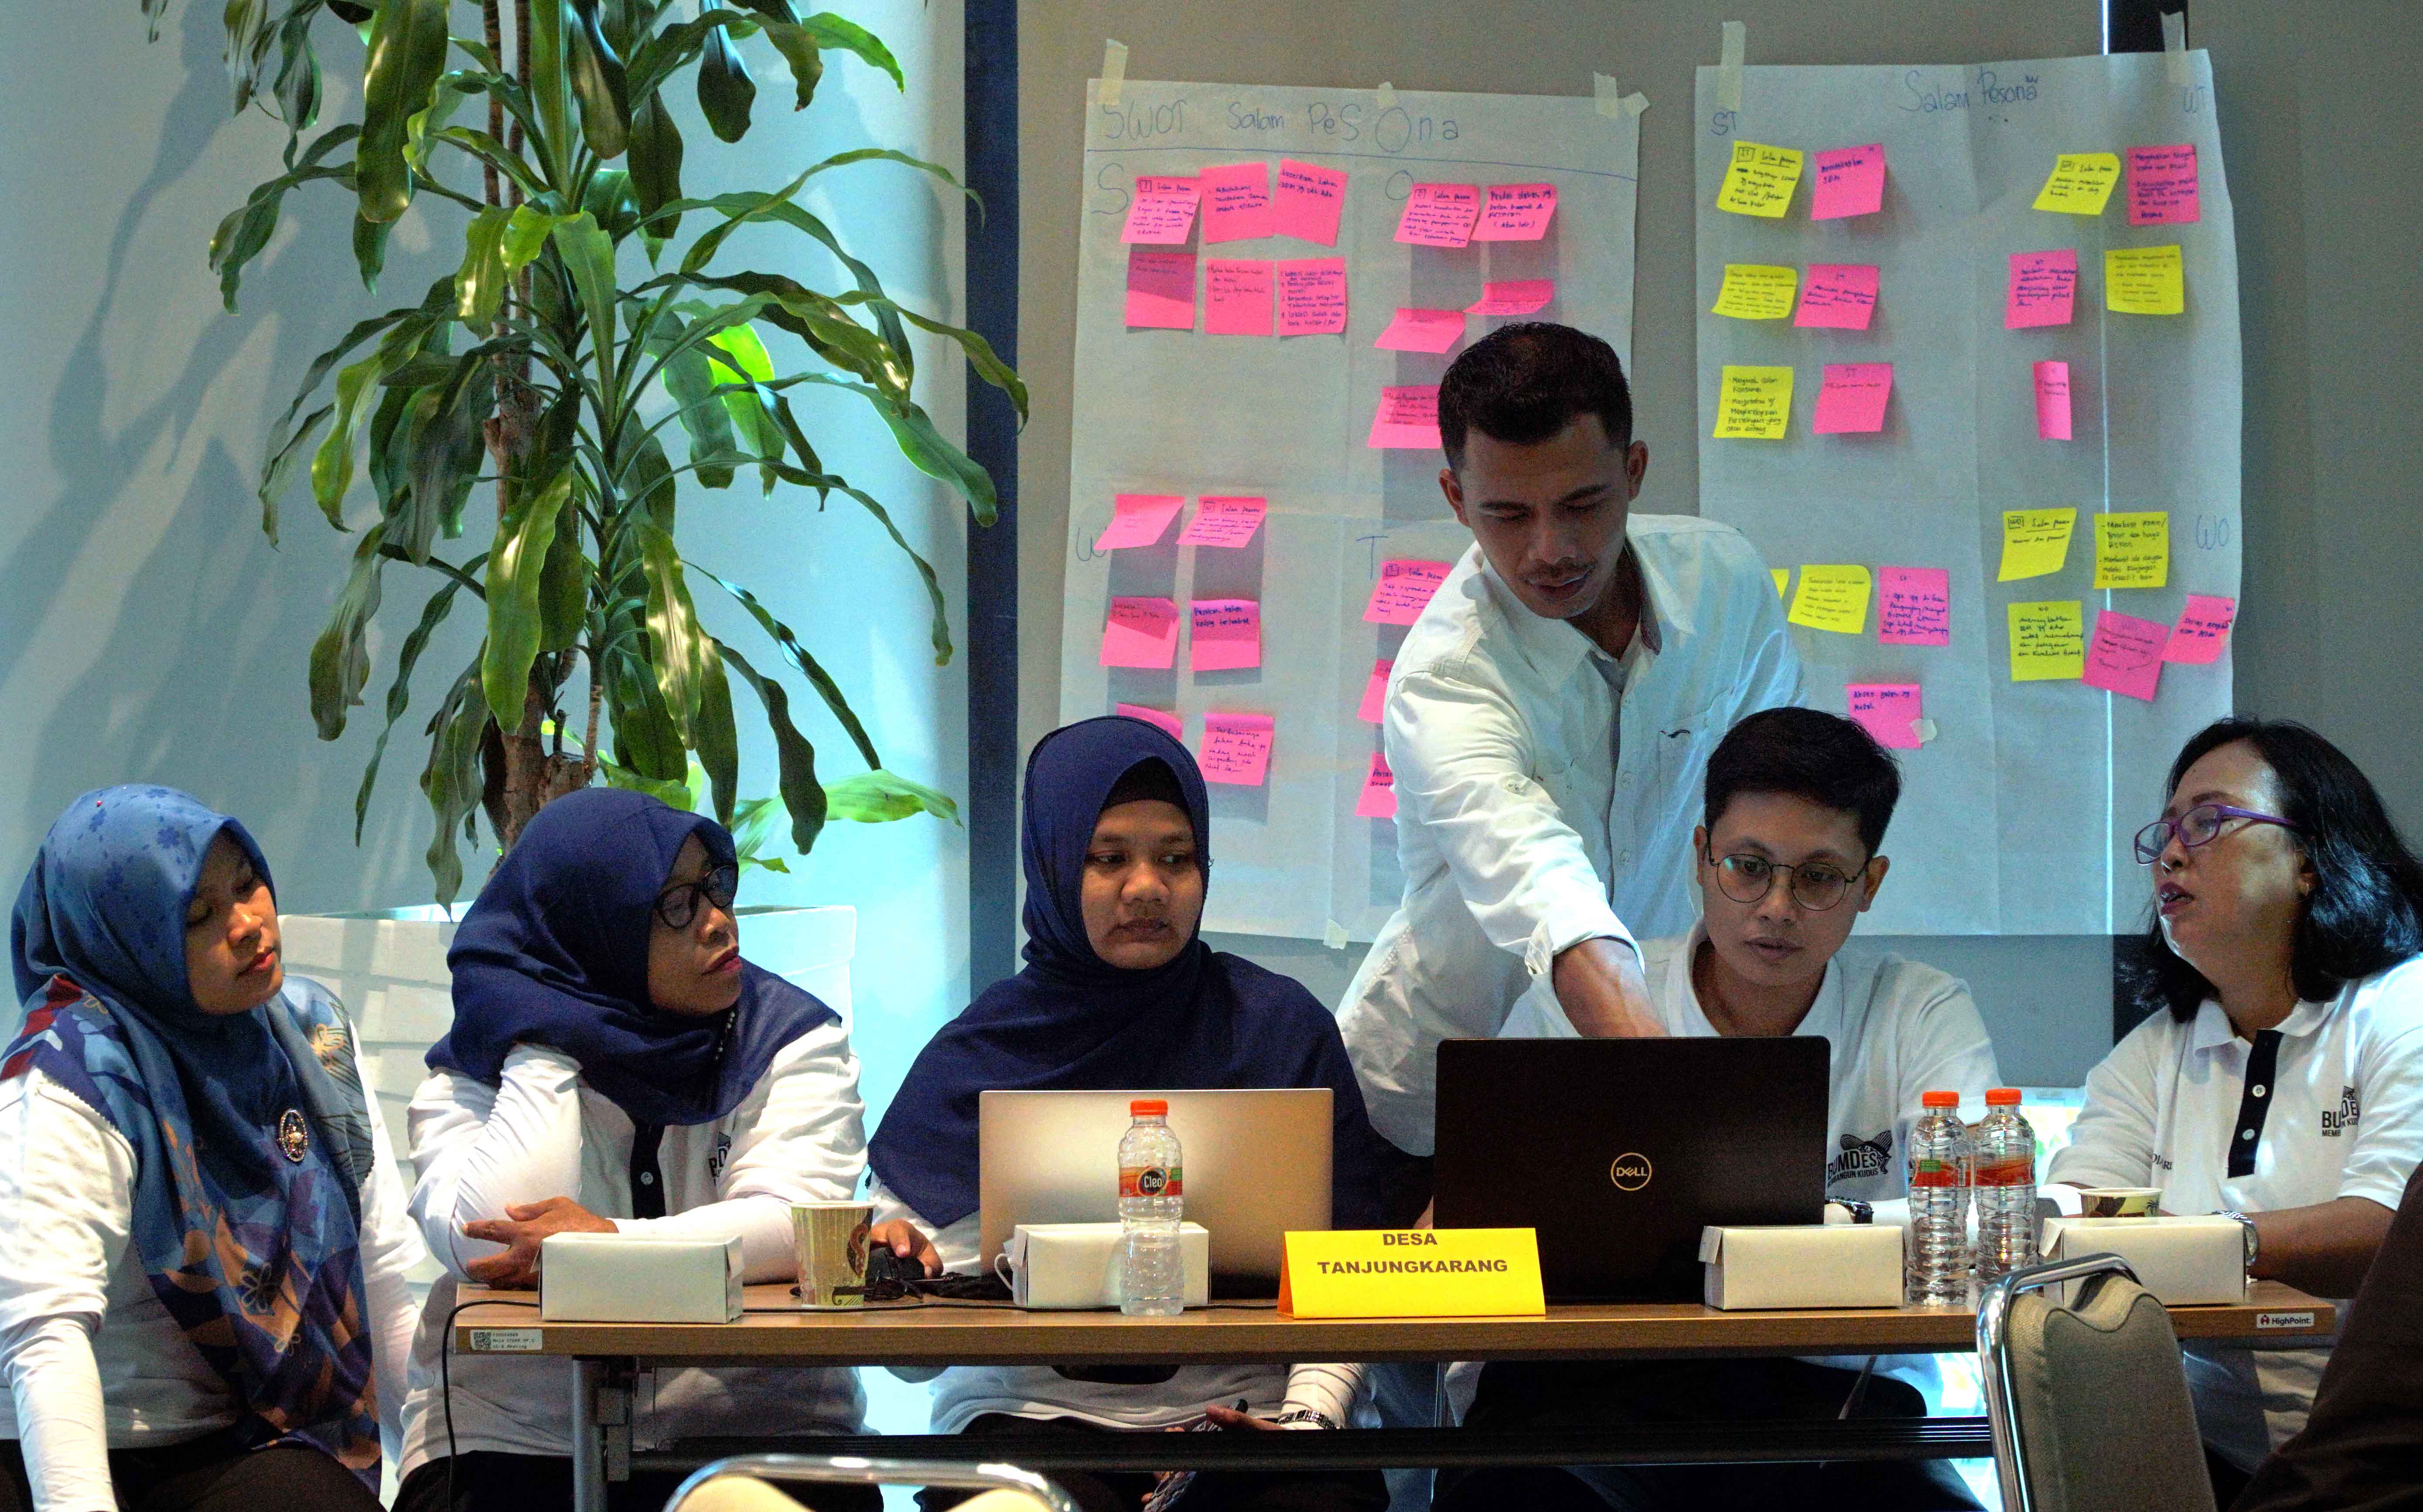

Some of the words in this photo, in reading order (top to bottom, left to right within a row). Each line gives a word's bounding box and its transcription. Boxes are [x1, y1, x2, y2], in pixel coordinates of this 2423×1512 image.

[1898, 70, 1969, 112] Salam
[1977, 66, 2038, 105] Pesona
[1102, 99, 1188, 139] SWOT
[1228, 102, 1285, 130] Salam
[1091, 163, 1128, 214] S
[2197, 514, 2229, 550] WO
[1356, 536, 1389, 579] T
[1143, 1175, 1162, 1188] Cleo
[1616, 1167, 1648, 1177] DELL
[1383, 1233, 1437, 1246] DESA
[1317, 1259, 1508, 1274] TANJUNGKARANG
